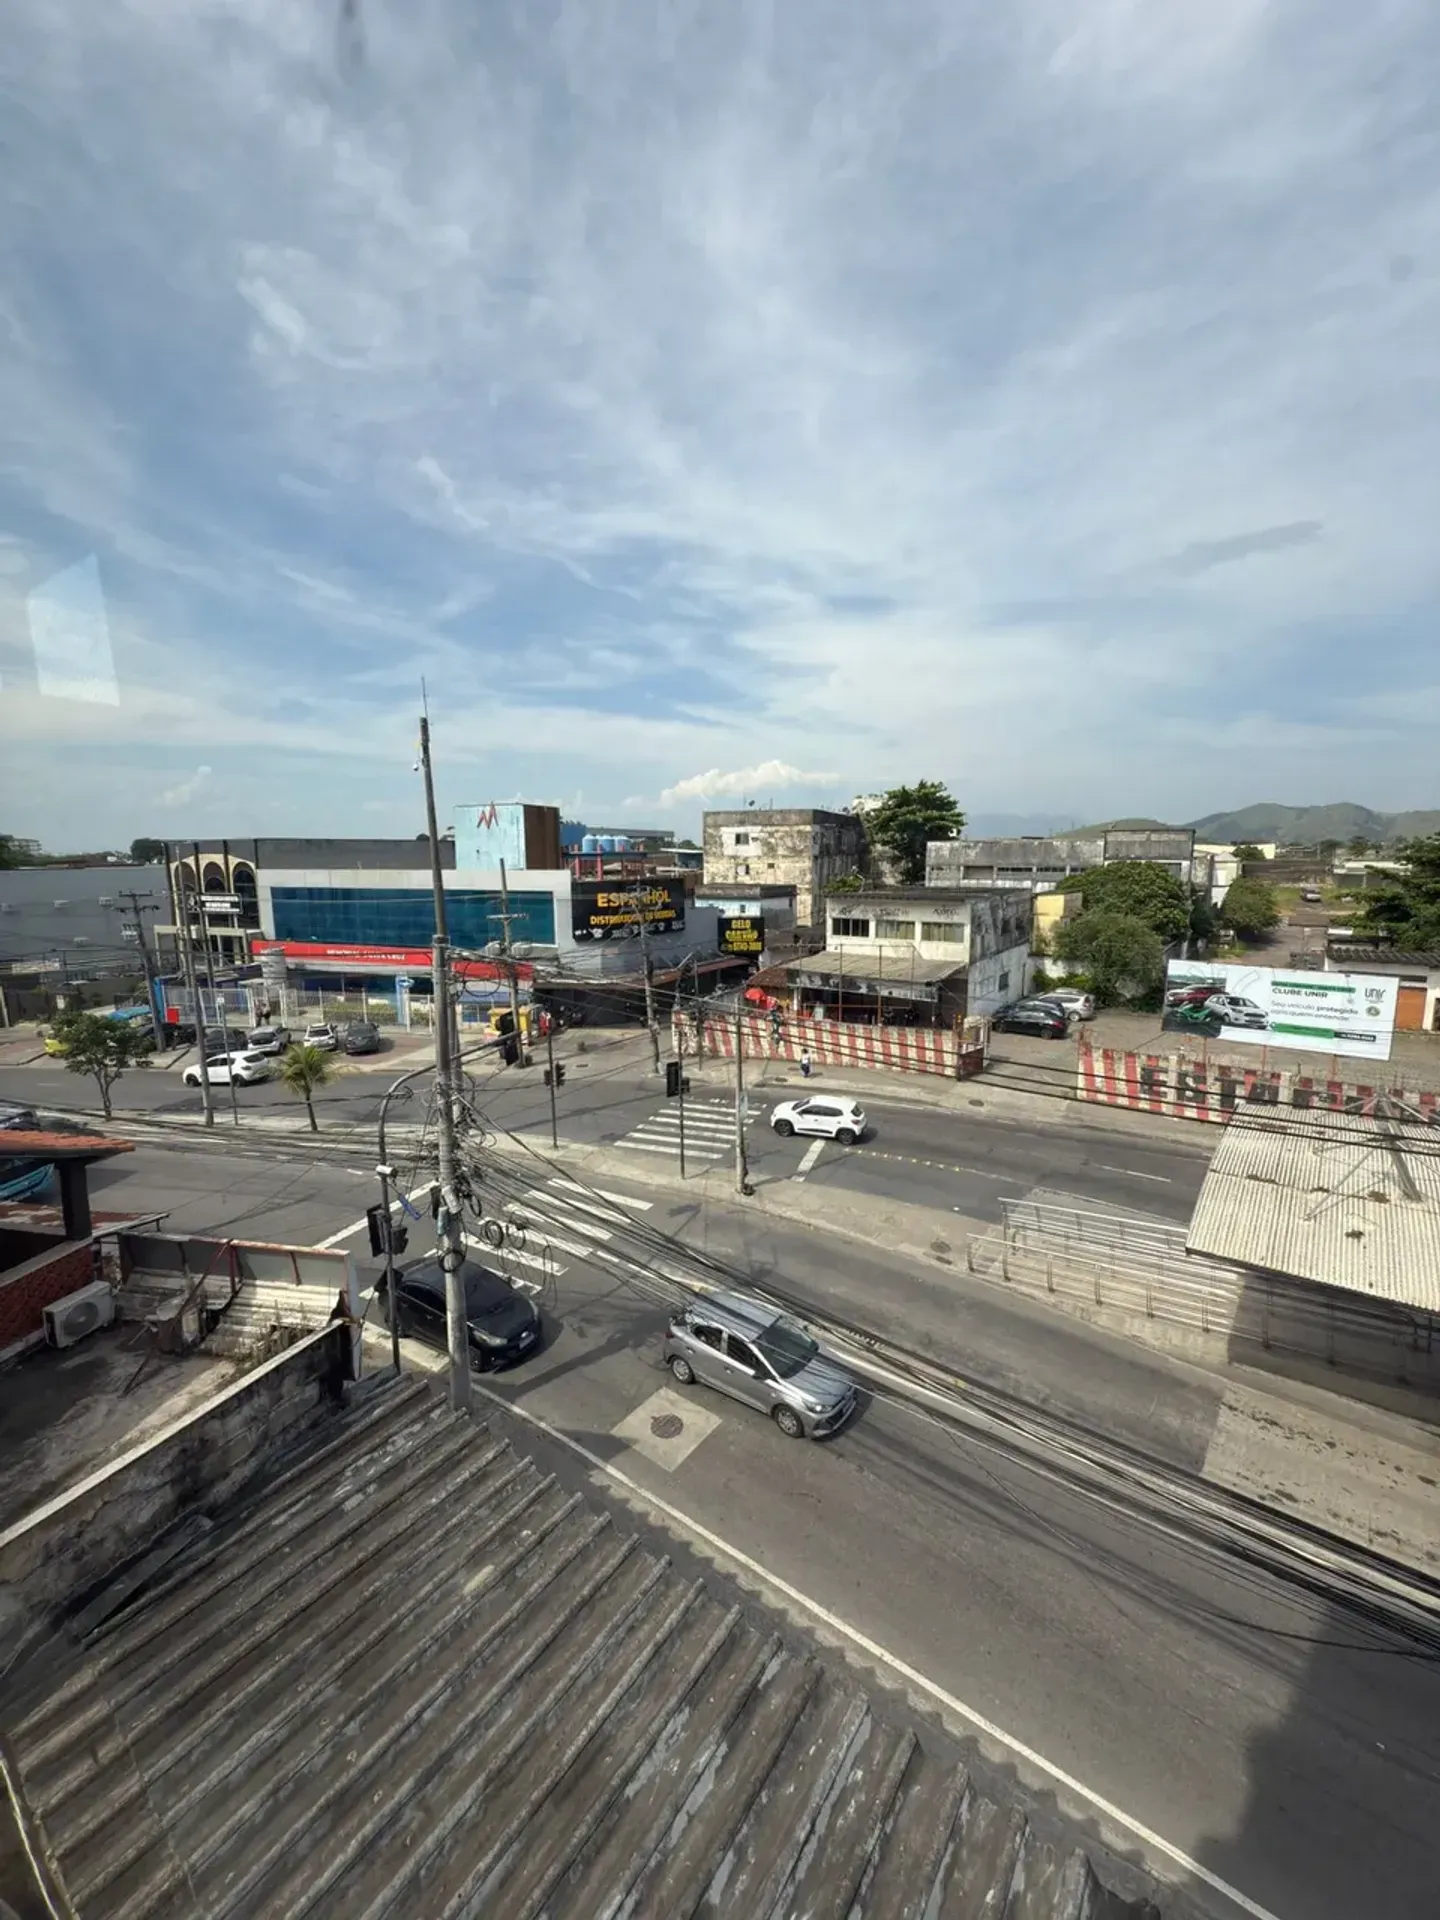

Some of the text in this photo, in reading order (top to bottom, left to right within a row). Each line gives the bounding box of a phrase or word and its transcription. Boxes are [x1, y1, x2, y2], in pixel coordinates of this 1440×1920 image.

[1272, 987, 1302, 997] CLUBE
[1304, 991, 1329, 999] UNIR
[1316, 1006, 1359, 1015] protegido
